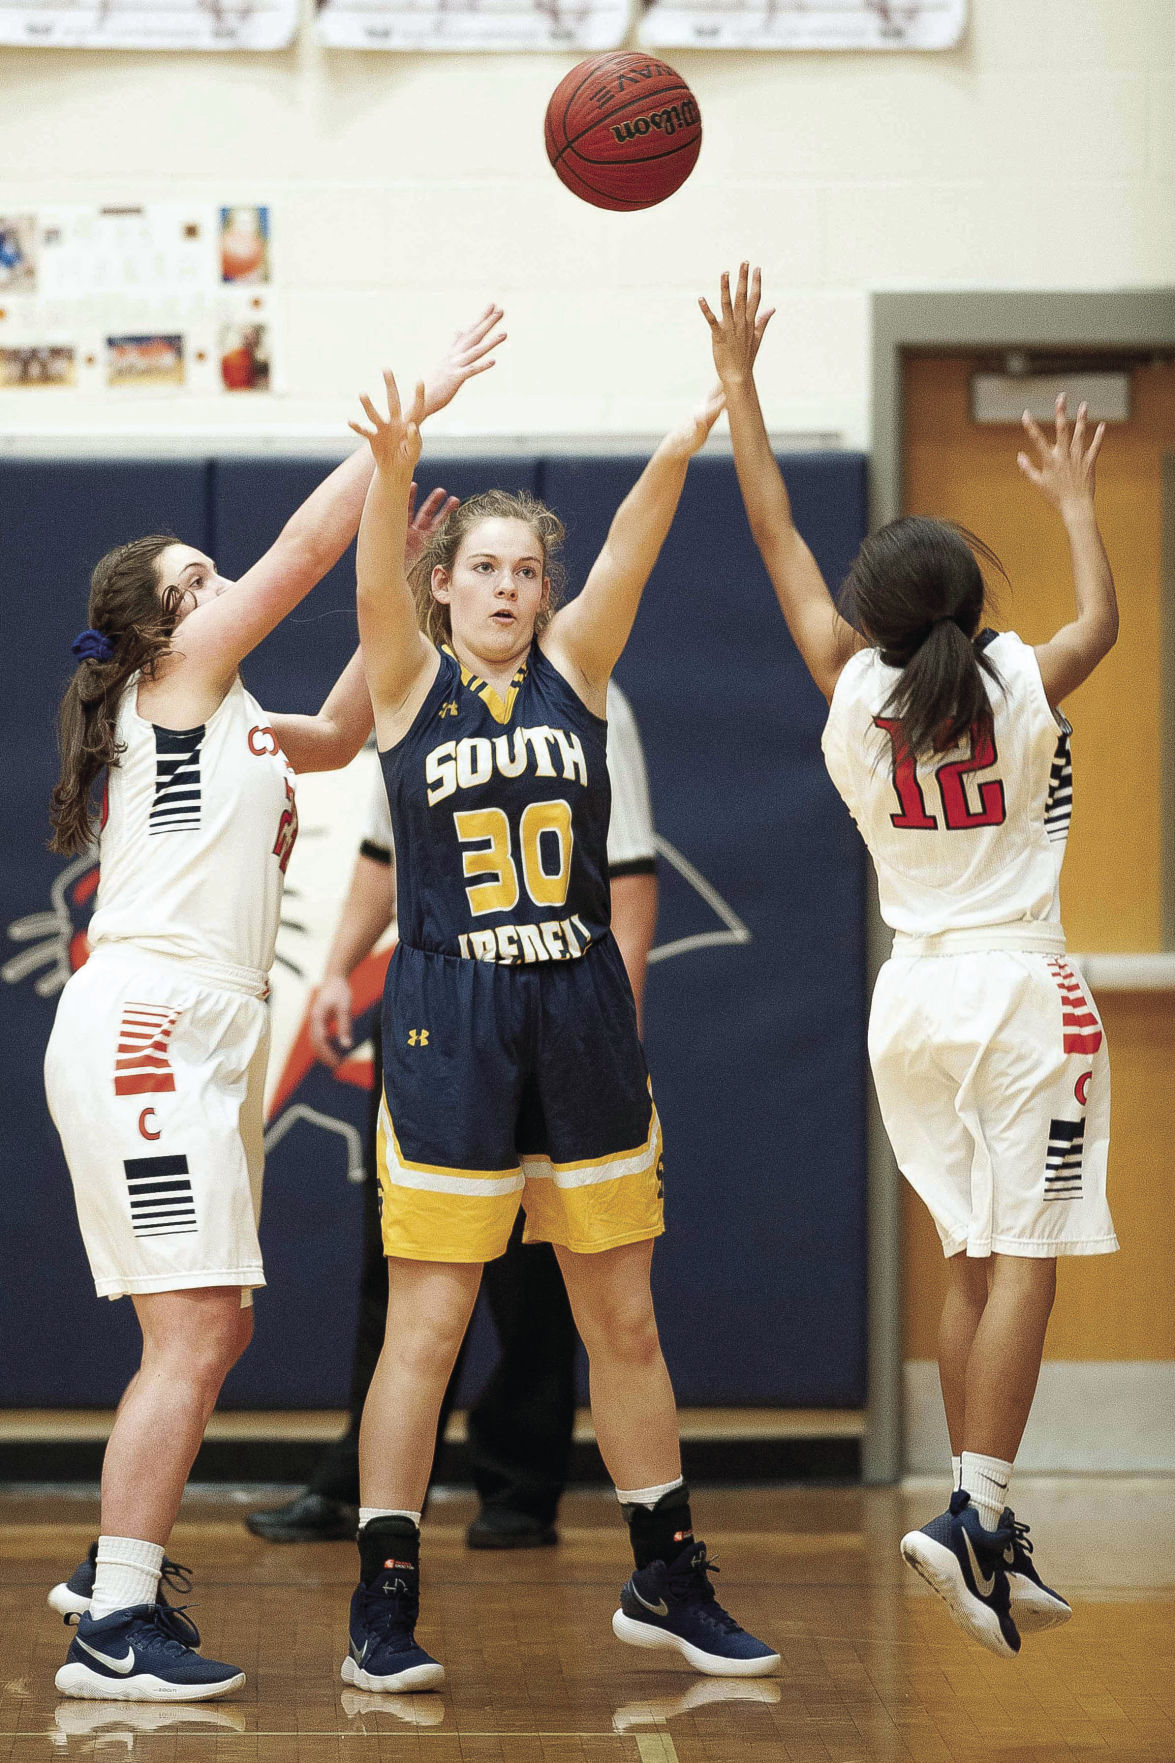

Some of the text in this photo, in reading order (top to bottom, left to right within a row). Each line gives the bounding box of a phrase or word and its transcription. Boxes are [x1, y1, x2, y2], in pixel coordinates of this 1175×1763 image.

[425, 725, 588, 808] SOUTH
[872, 708, 1007, 831] 12
[453, 799, 574, 917] 30
[138, 1107, 162, 1141] C
